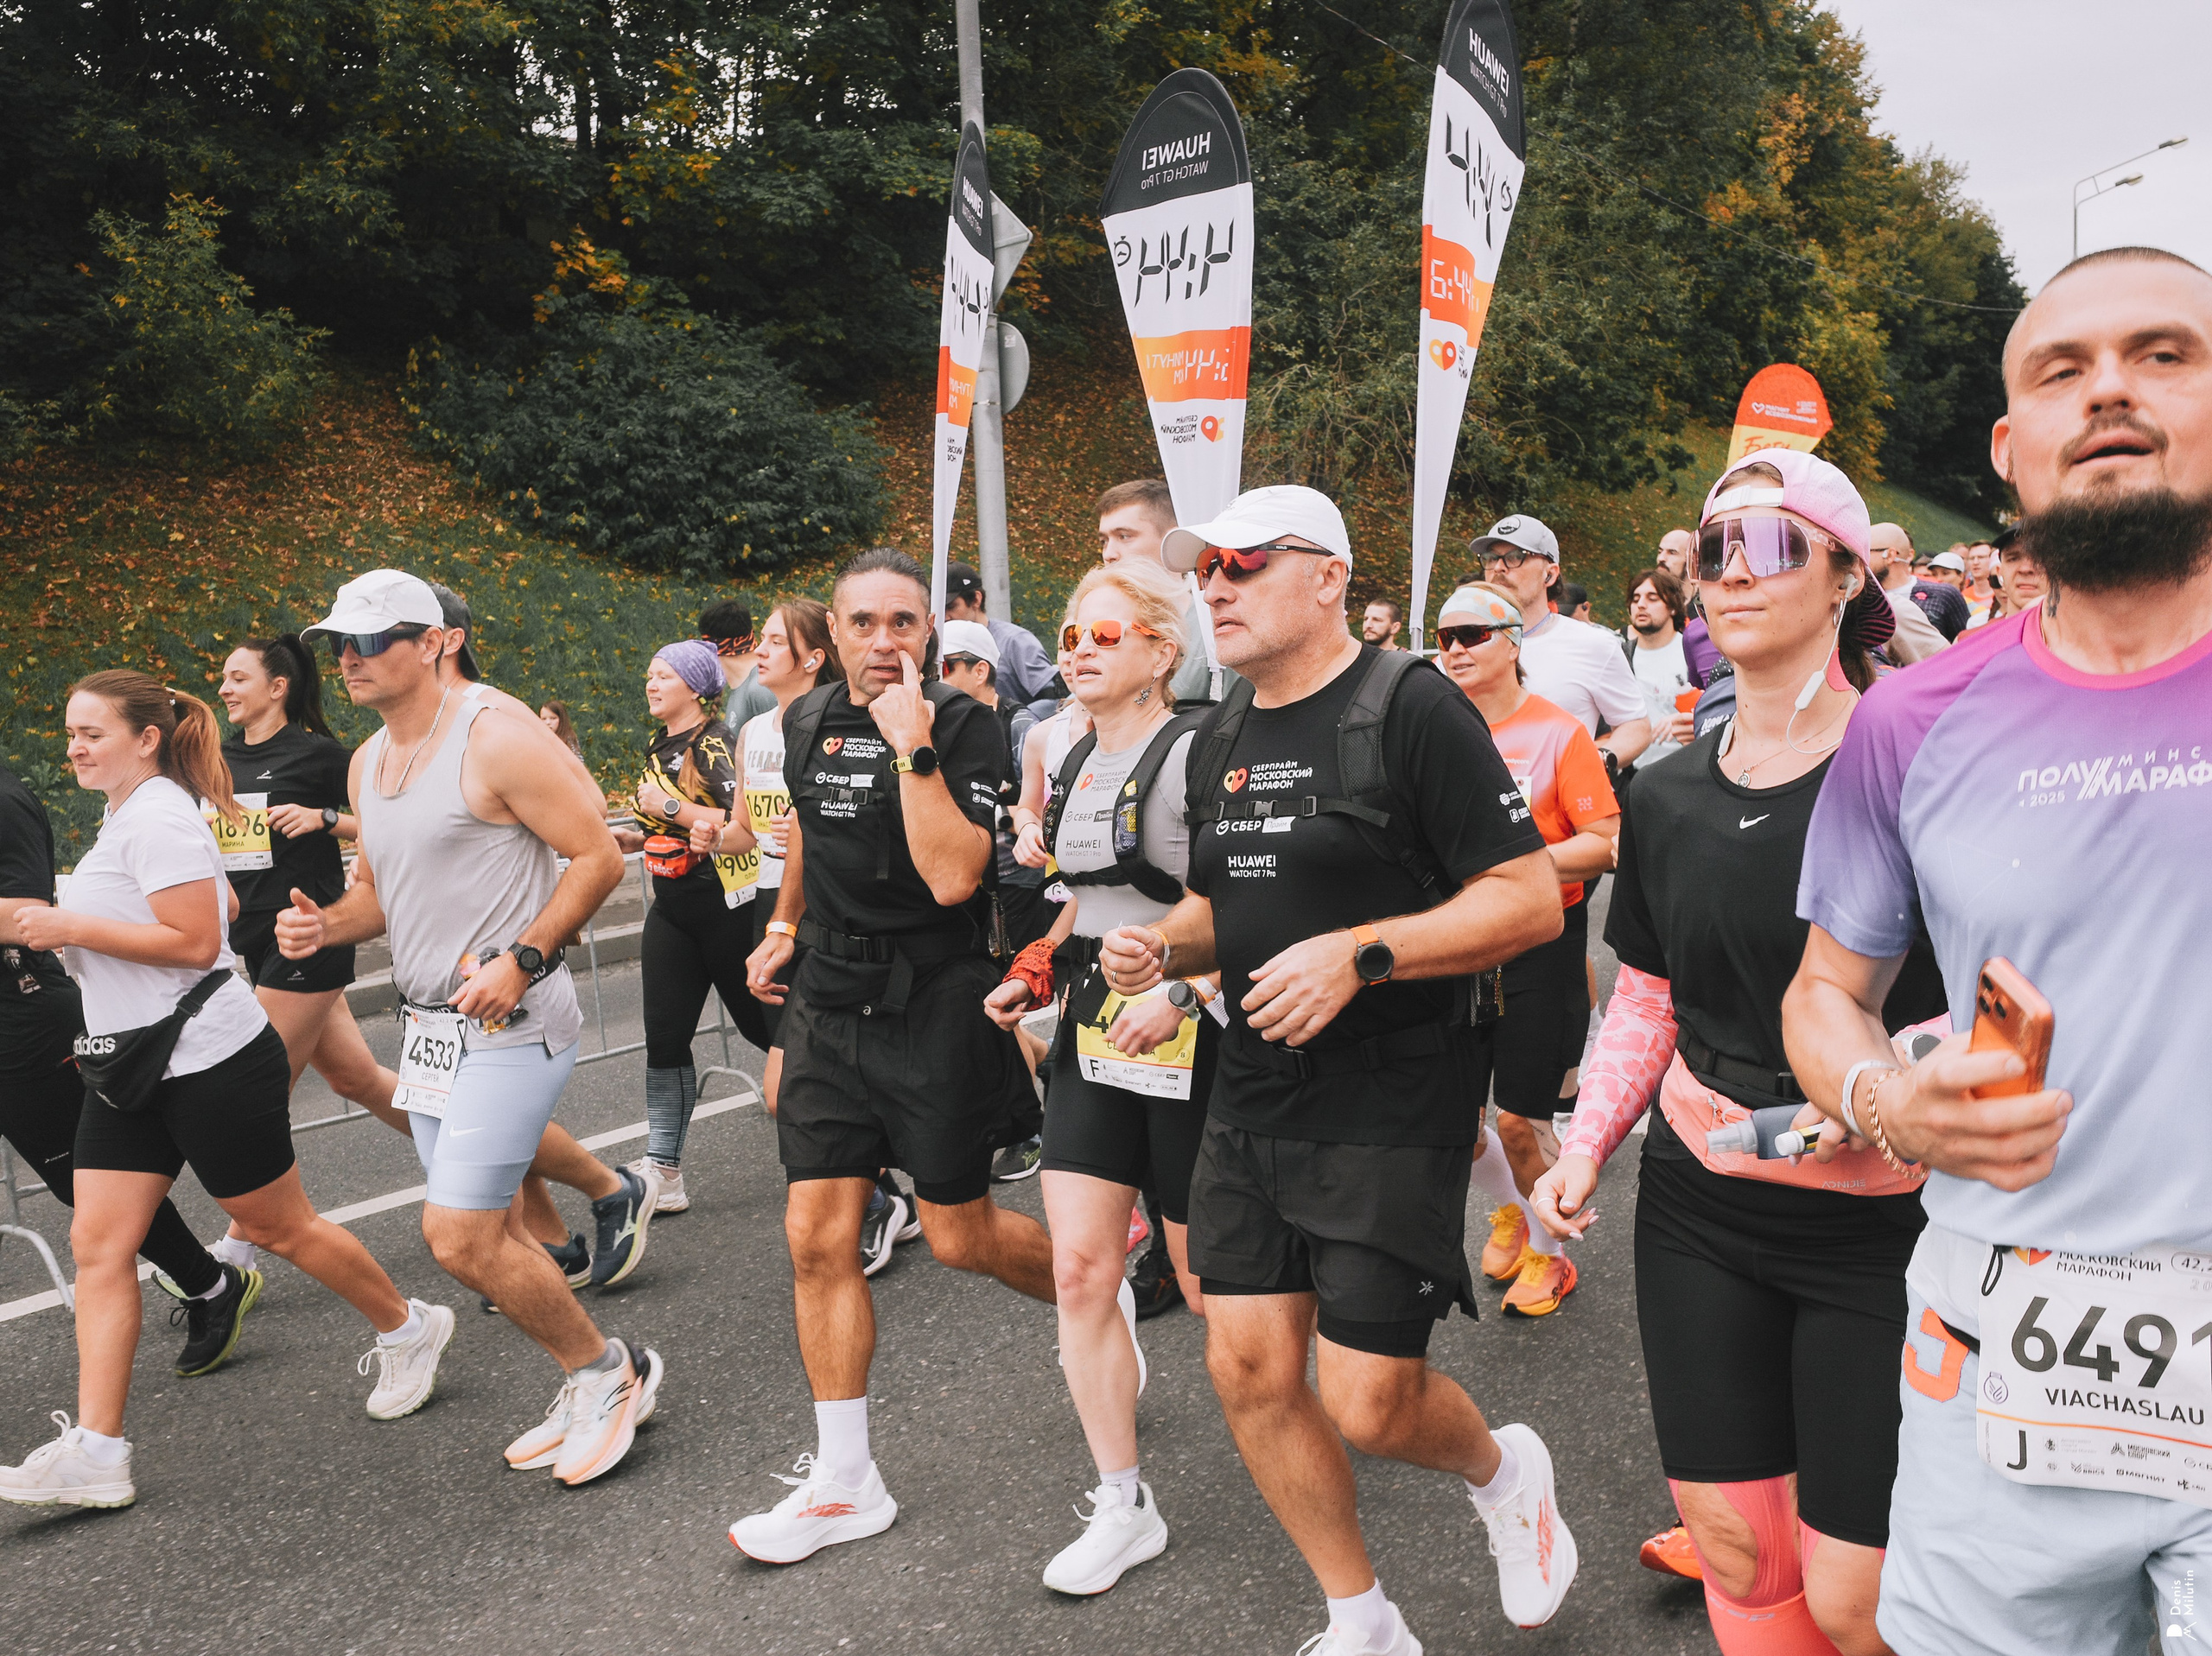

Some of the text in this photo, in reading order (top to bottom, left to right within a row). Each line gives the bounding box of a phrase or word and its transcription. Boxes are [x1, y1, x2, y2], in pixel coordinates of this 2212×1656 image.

[1470, 27, 1510, 98] HUAWEI
[845, 737, 882, 746] СБЕРПРАЙМ
[841, 750, 878, 759] МАРАФОН
[1251, 760, 1298, 773] СБЕРПРАЙМ
[826, 774, 850, 785] СБЕР
[1093, 776, 1127, 786] МОСКОВСК
[1249, 766, 1313, 783] МОСКОВСКИЙ
[1249, 779, 1294, 792] МАРАФОН
[821, 800, 859, 811] HUAWEI
[2030, 790, 2066, 809] 2025
[1073, 812, 1094, 822] СБЕР
[1230, 821, 1262, 832] СБЕР
[1065, 839, 1102, 849] HUAWEI
[1227, 854, 1276, 868] HUAWEI
[1229, 869, 1276, 878] WATCH GT 7 Pro
[408, 1035, 455, 1071] 4533
[1090, 1058, 1099, 1077] F
[401, 1088, 410, 1105] J
[2059, 1251, 2161, 1272] МОСКОВСКИЙ
[2056, 1261, 2132, 1281] МАРАФОН
[2044, 1387, 2205, 1425] VIACHASLAU
[2006, 1430, 2027, 1470] J
